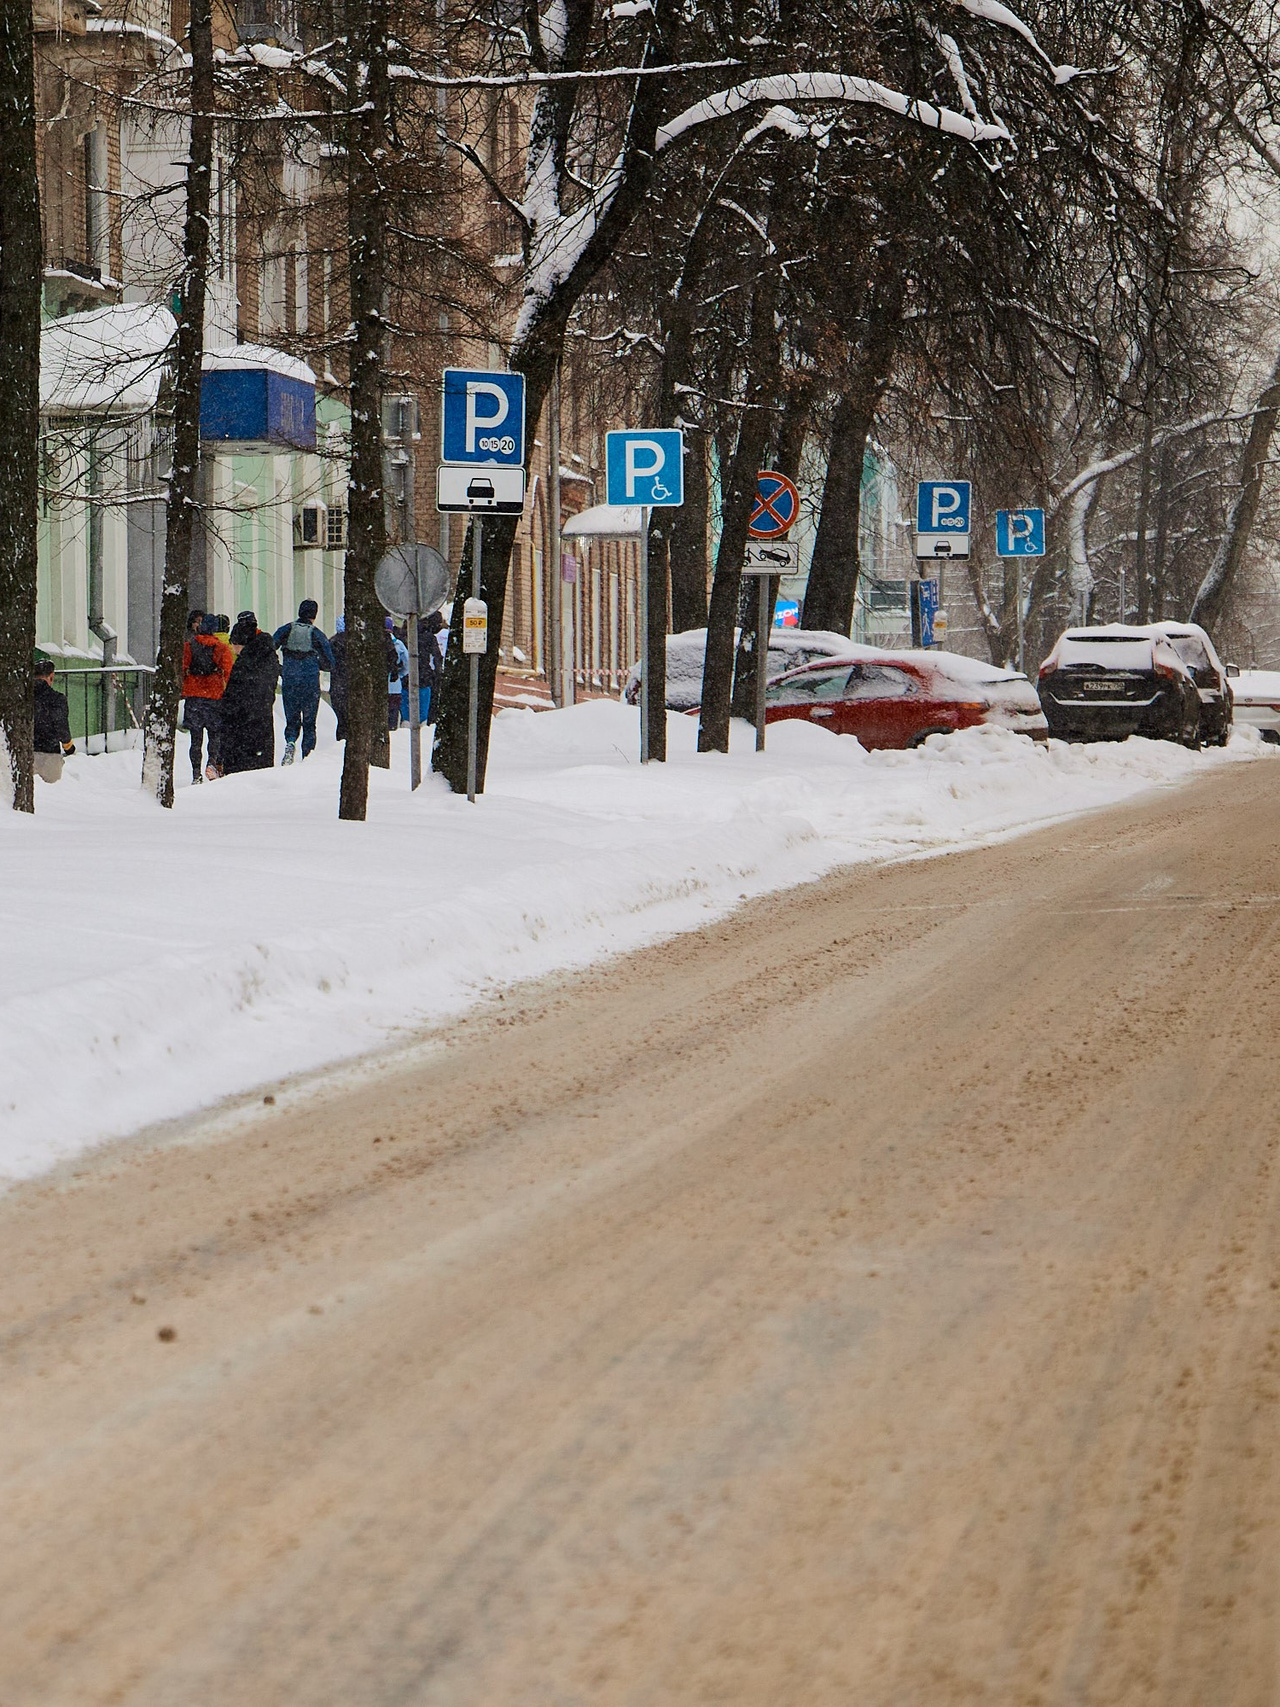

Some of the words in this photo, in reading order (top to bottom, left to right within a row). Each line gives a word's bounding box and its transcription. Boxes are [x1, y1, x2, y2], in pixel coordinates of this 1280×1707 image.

[465, 381, 510, 453] P
[490, 440, 499, 449] 15
[501, 439, 514, 451] 20
[625, 440, 666, 498] P
[932, 487, 961, 528] P
[1008, 514, 1034, 551] P
[775, 607, 799, 620] ZON
